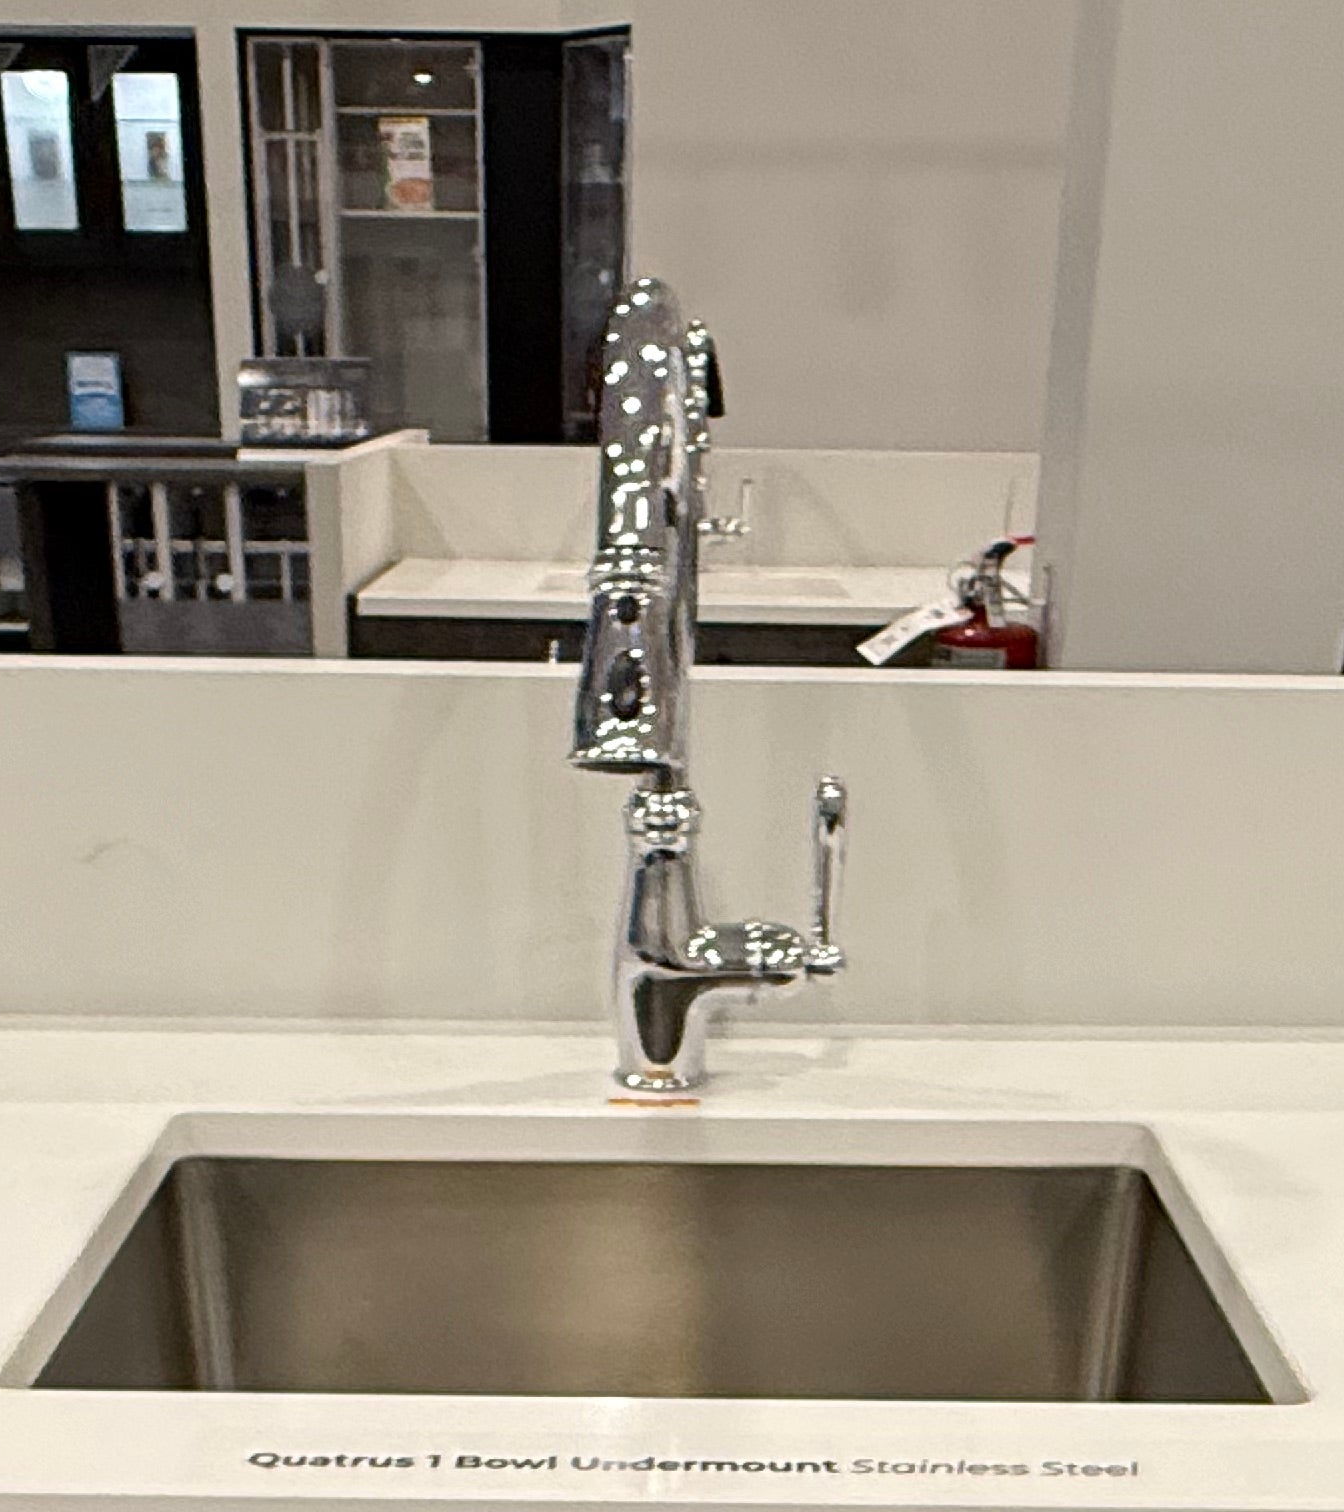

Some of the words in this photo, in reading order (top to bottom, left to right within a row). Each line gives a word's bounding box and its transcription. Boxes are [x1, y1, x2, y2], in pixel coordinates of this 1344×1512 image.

[246, 1452, 415, 1470] Quatrus
[426, 1454, 442, 1469] 1
[454, 1454, 558, 1471] Bowl
[570, 1456, 840, 1474] Undermount
[849, 1458, 1030, 1476] Stainless
[1040, 1460, 1139, 1478] Steel
